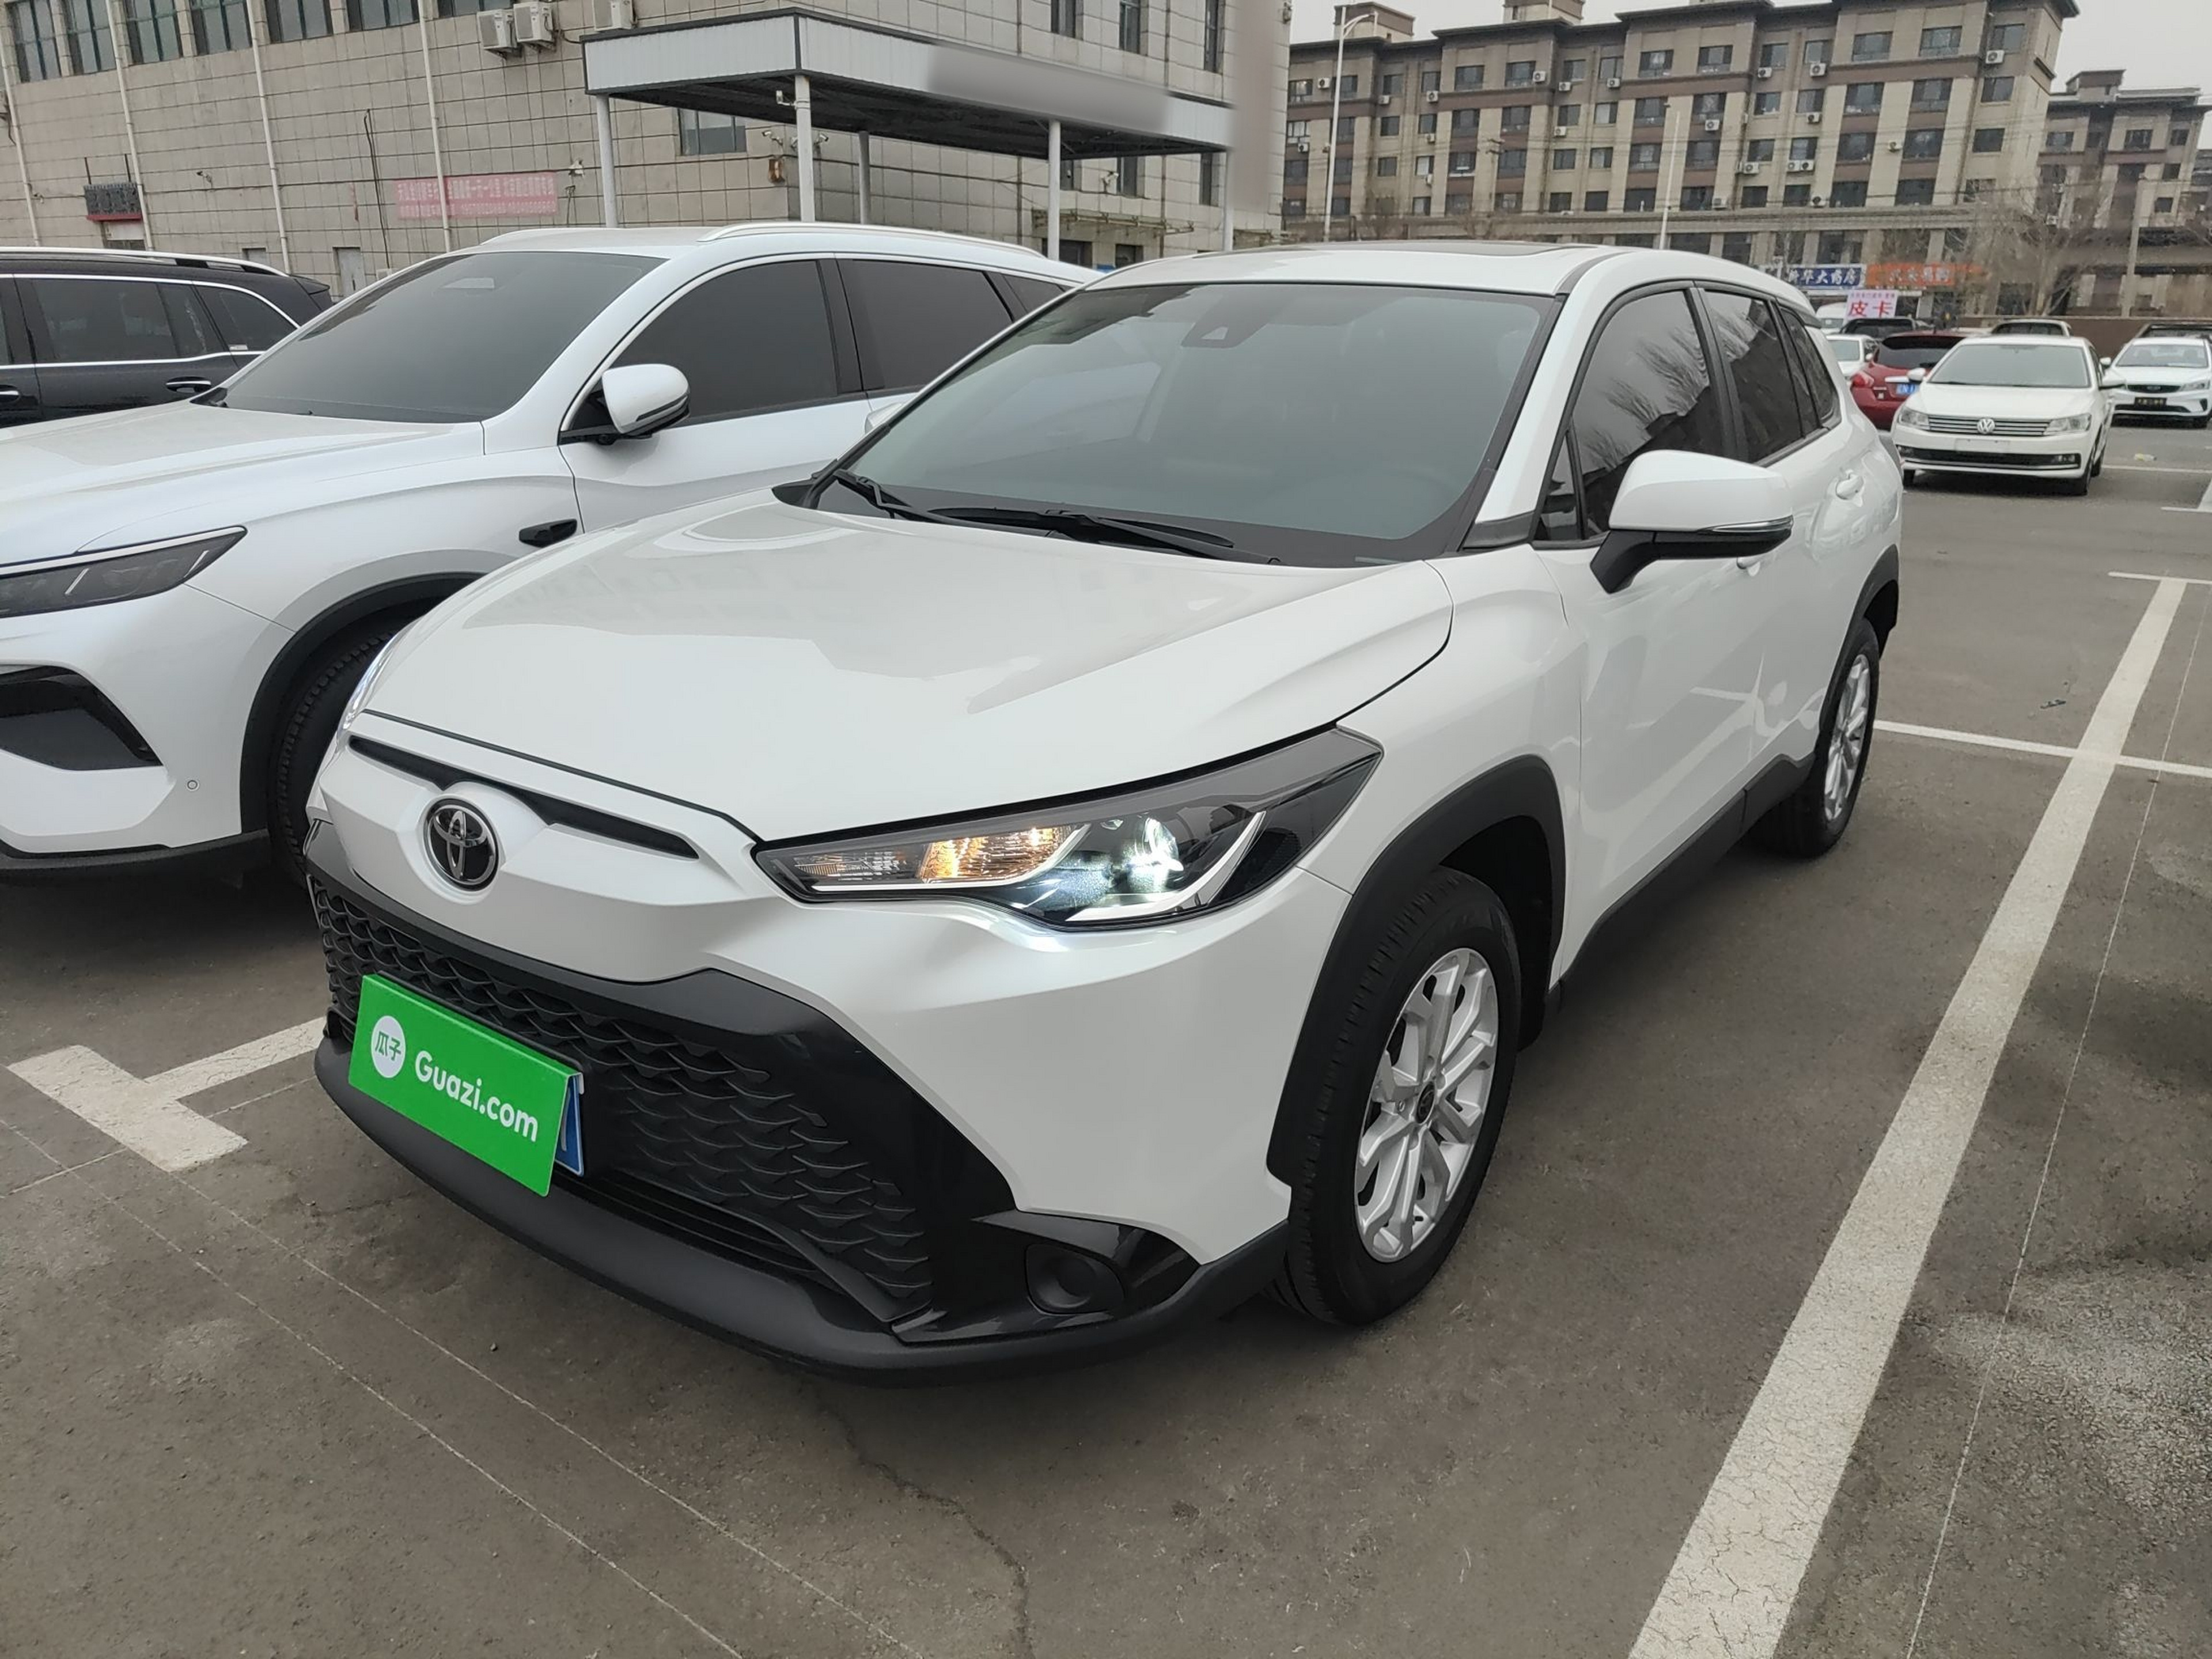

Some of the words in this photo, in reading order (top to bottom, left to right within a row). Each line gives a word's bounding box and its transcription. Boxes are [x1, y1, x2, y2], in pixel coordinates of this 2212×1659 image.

[1847, 300, 1893, 318] 皮卡
[375, 1031, 402, 1061] 瓜子
[415, 1050, 538, 1142] Guazi.com
